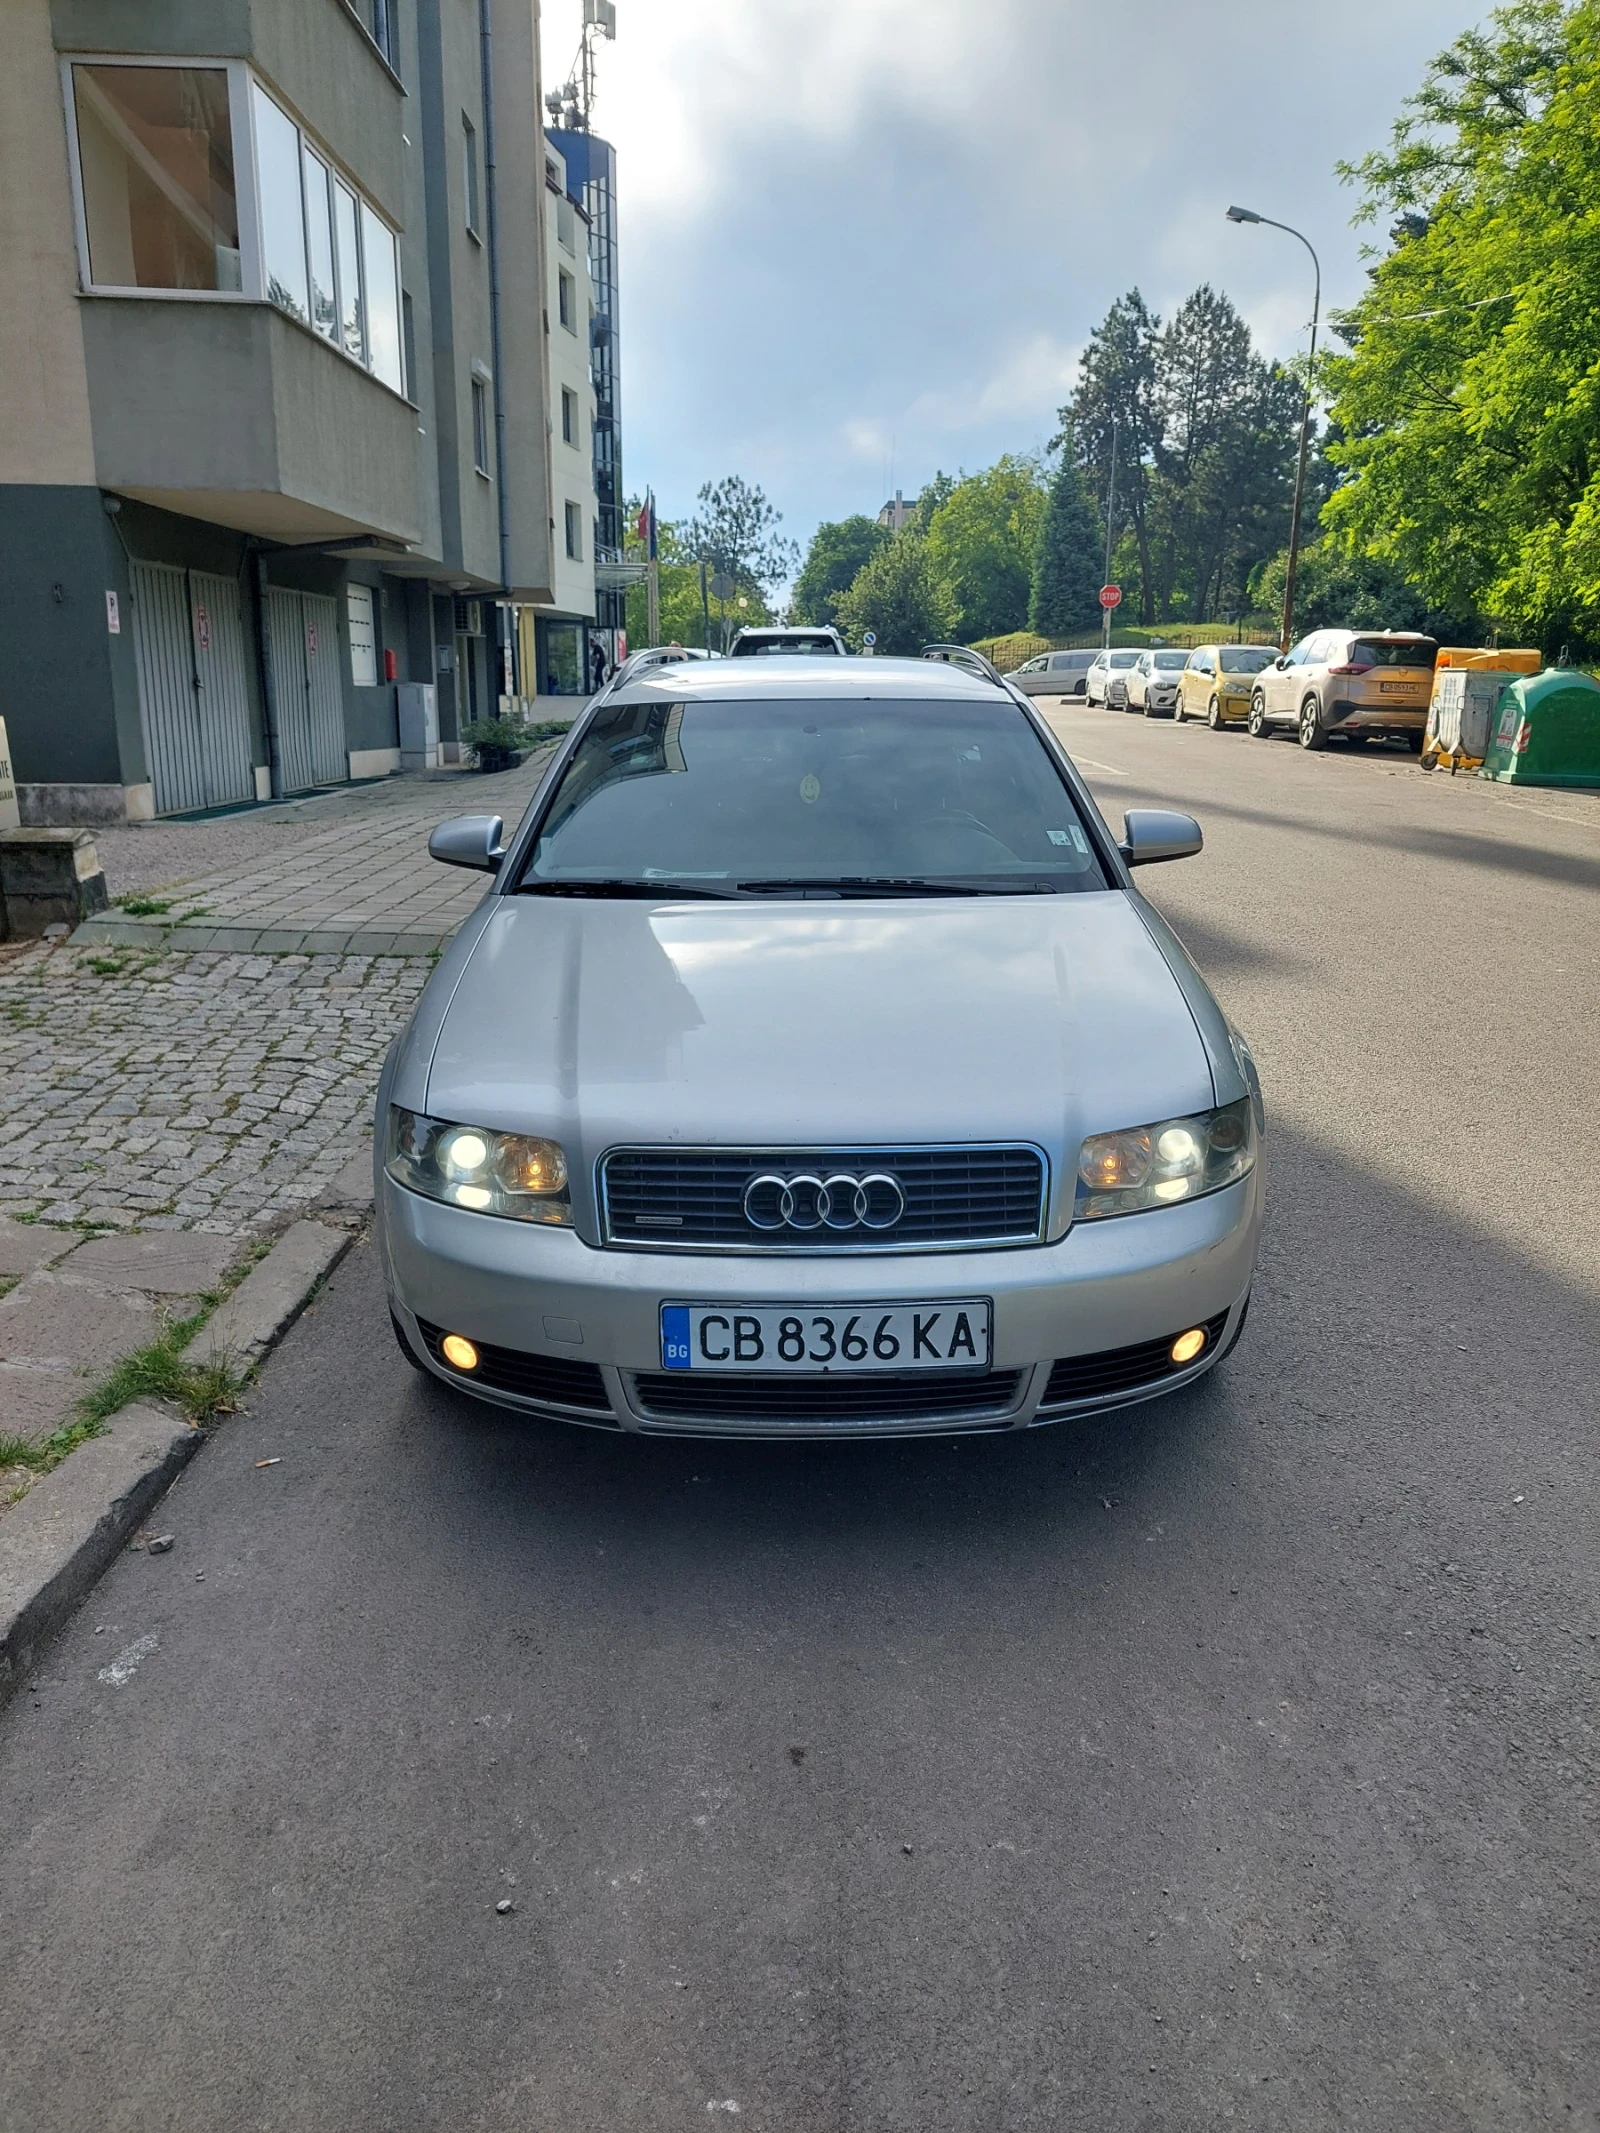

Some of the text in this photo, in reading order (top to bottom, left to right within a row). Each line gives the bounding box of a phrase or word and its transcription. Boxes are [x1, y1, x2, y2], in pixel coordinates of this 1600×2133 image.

[1102, 592, 1119, 601] STOP
[700, 1311, 978, 1362] CB 8366 KA
[668, 1344, 688, 1358] BG
